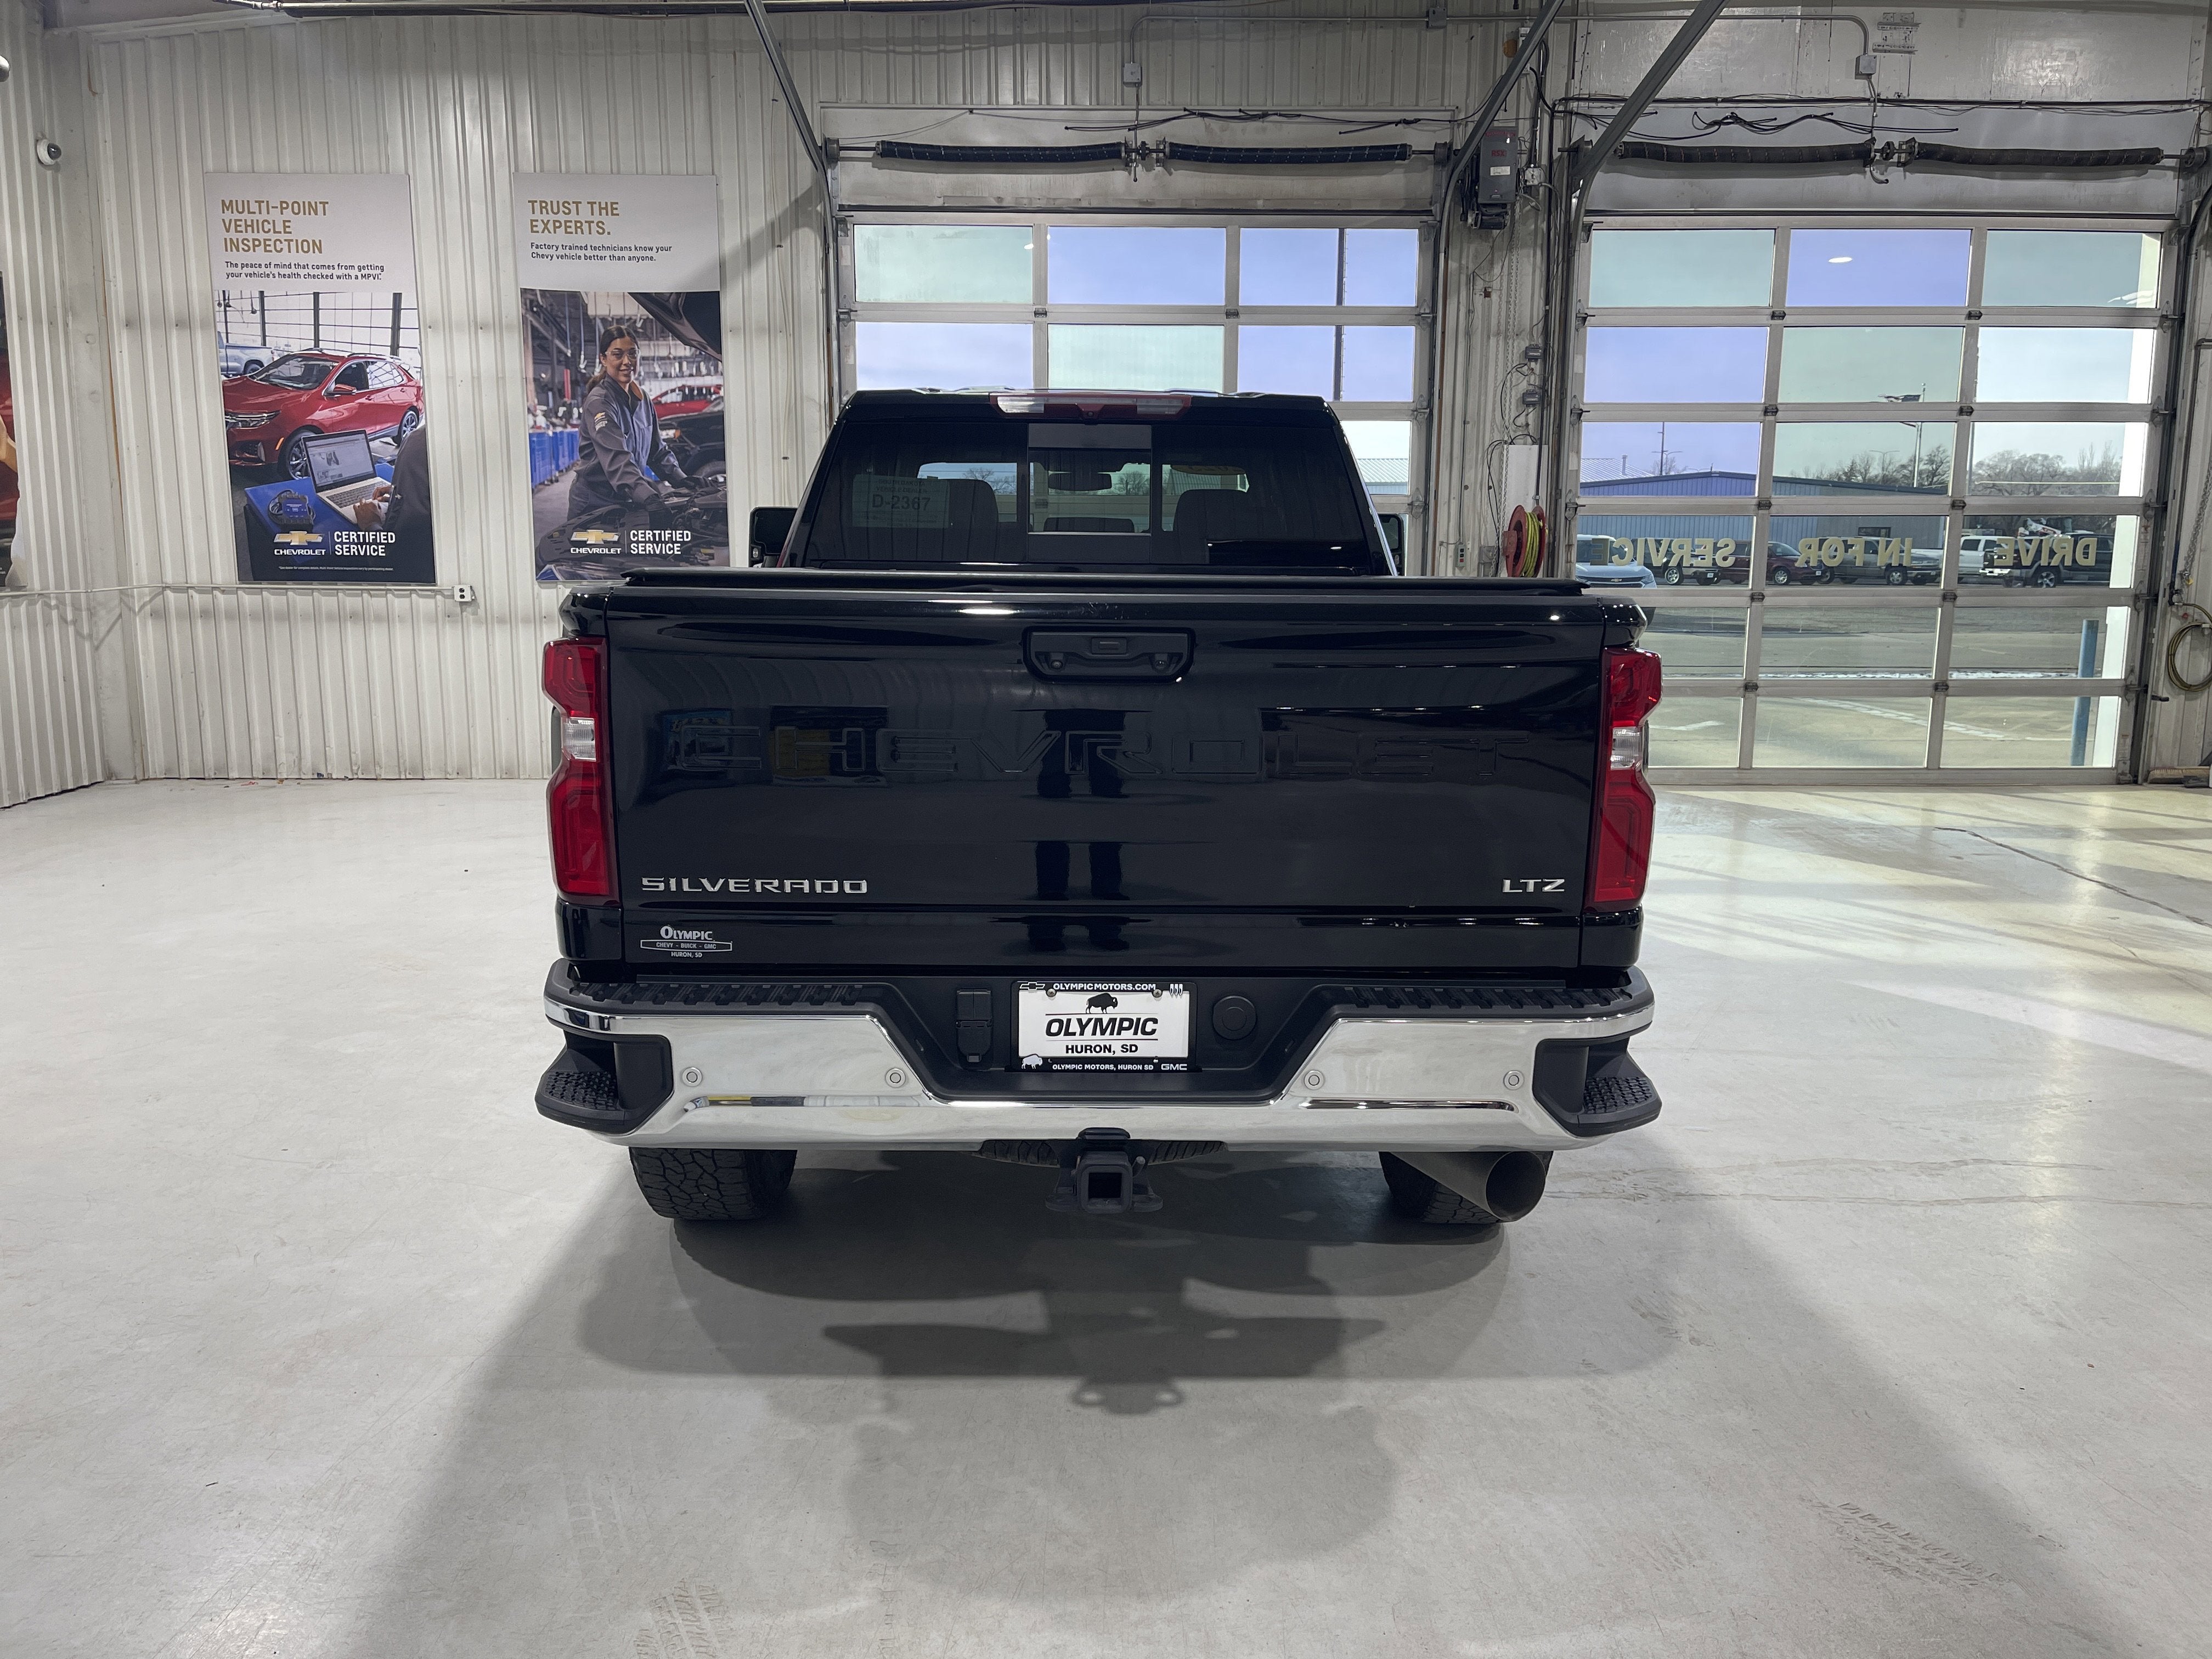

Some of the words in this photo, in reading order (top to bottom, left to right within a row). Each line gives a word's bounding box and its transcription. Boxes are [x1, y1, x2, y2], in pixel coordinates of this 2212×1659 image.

[221, 199, 329, 216] MULTI-POINT
[528, 200, 582, 216] TRUST
[587, 201, 620, 217] THE
[222, 218, 292, 234] VEHICLE
[530, 219, 611, 235] EXPERTS.
[224, 238, 323, 254] INSPECTION
[531, 242, 559, 251] Factory
[531, 252, 554, 261] Chevy
[358, 264, 384, 272] getting
[872, 494, 931, 511] D-2367
[334, 531, 396, 543] CERTIFIED
[630, 530, 691, 541] CERTIFIED
[335, 544, 386, 556] SERVICE
[630, 543, 681, 555] SERVICE
[681, 725, 1530, 775] CHEVROLET
[641, 877, 868, 894] SILVERADO
[1502, 878, 1565, 893] LTZ
[660, 926, 713, 940] OLYMPIC
[1045, 1017, 1158, 1037] OLYMPIC
[1065, 1044, 1116, 1056] HURON,
[1121, 1043, 1138, 1053] SD
